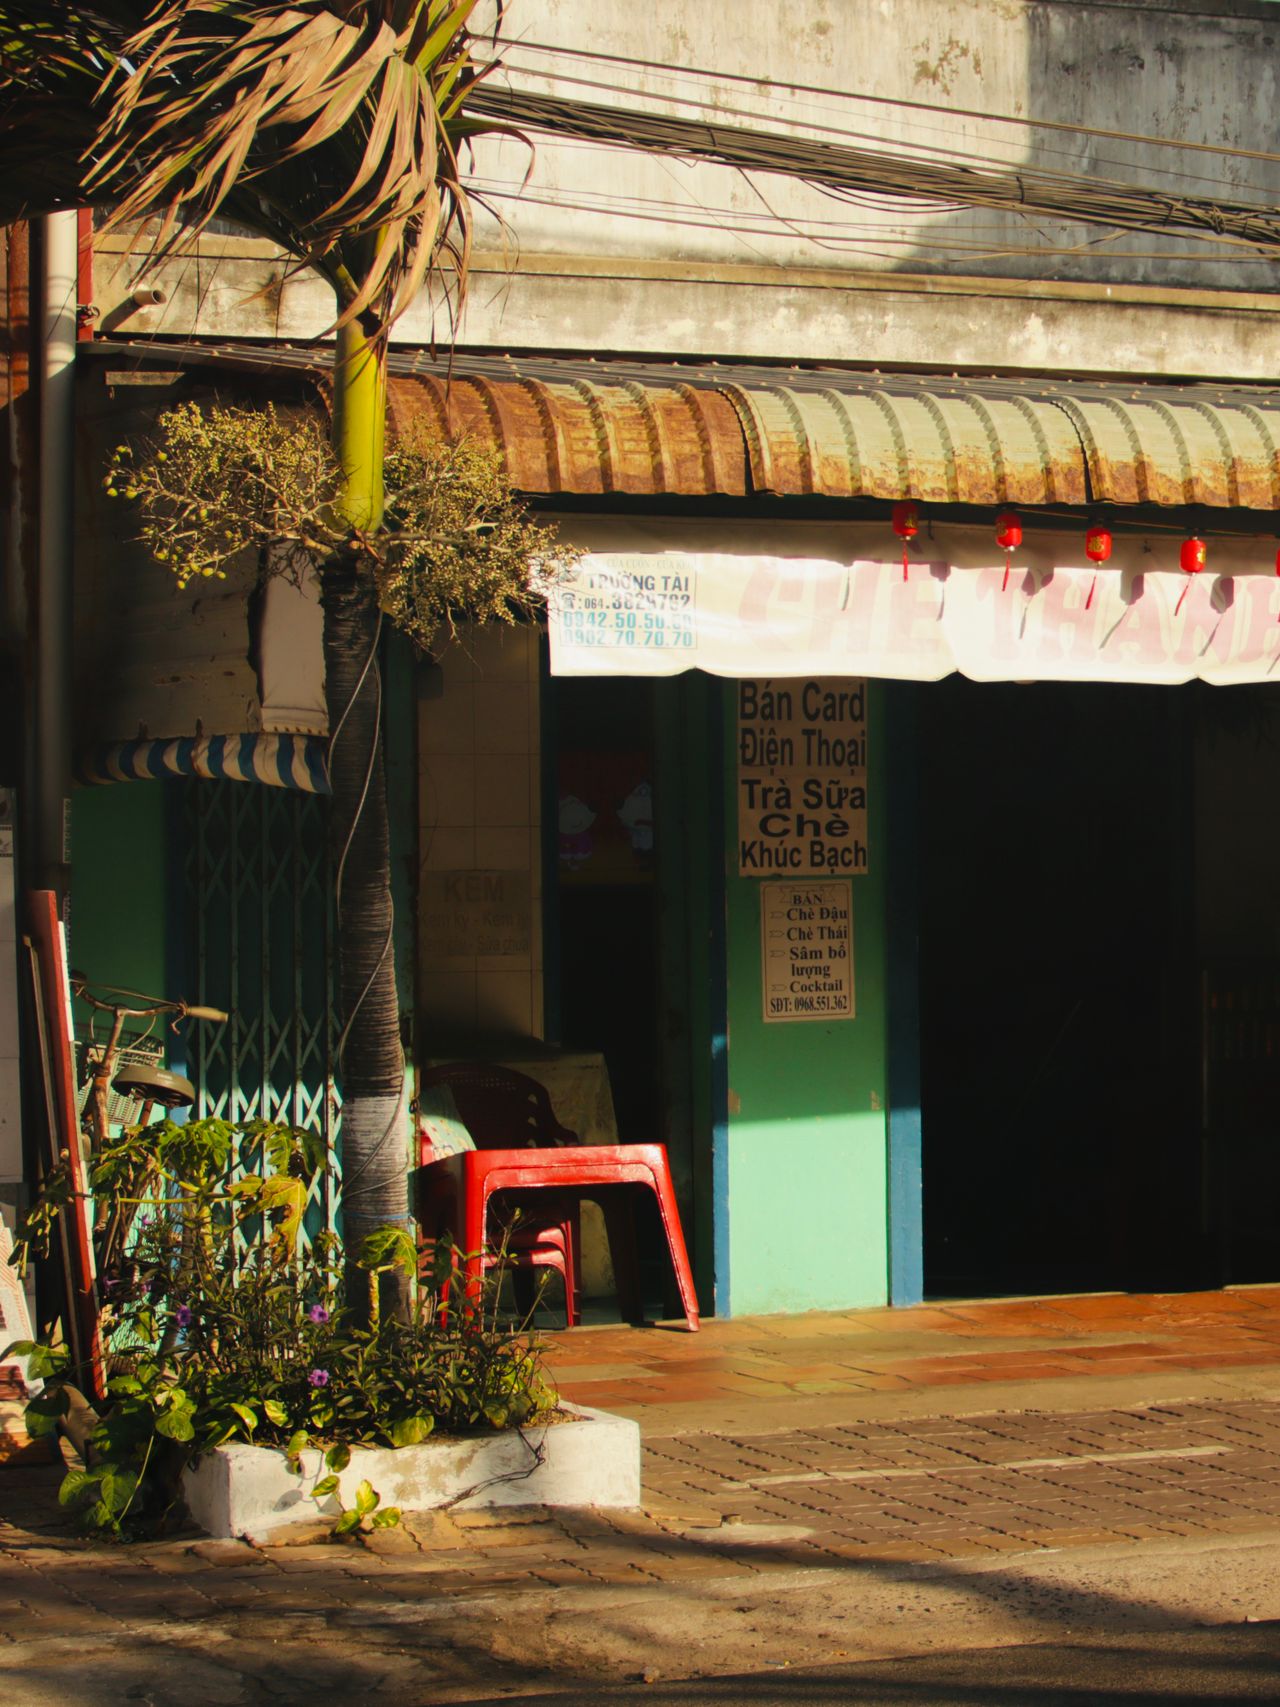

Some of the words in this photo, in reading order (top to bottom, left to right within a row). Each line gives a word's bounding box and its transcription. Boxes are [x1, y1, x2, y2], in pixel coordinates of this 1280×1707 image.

[661, 571, 689, 592] TÀI
[740, 681, 792, 721] Bán
[802, 681, 864, 722] Card
[740, 727, 793, 776] Điện
[802, 729, 865, 776] Thoại
[741, 779, 791, 809] Trà
[803, 779, 865, 809] Sữa
[759, 813, 849, 838] Chè
[741, 840, 801, 868] Khúc
[810, 840, 867, 874] Bạch
[443, 876, 504, 903] KEM
[793, 891, 823, 905] BÁN
[786, 907, 815, 921] Chè
[819, 906, 848, 922] Đậu
[786, 926, 813, 941] Chè
[817, 925, 848, 940] Thái
[789, 946, 823, 960] Sâm
[828, 941, 847, 959] bổ
[791, 963, 831, 979] lượng
[789, 980, 843, 993] Cocktail
[770, 997, 792, 1013] SĐT:
[794, 995, 847, 1011] 0968.551.362
